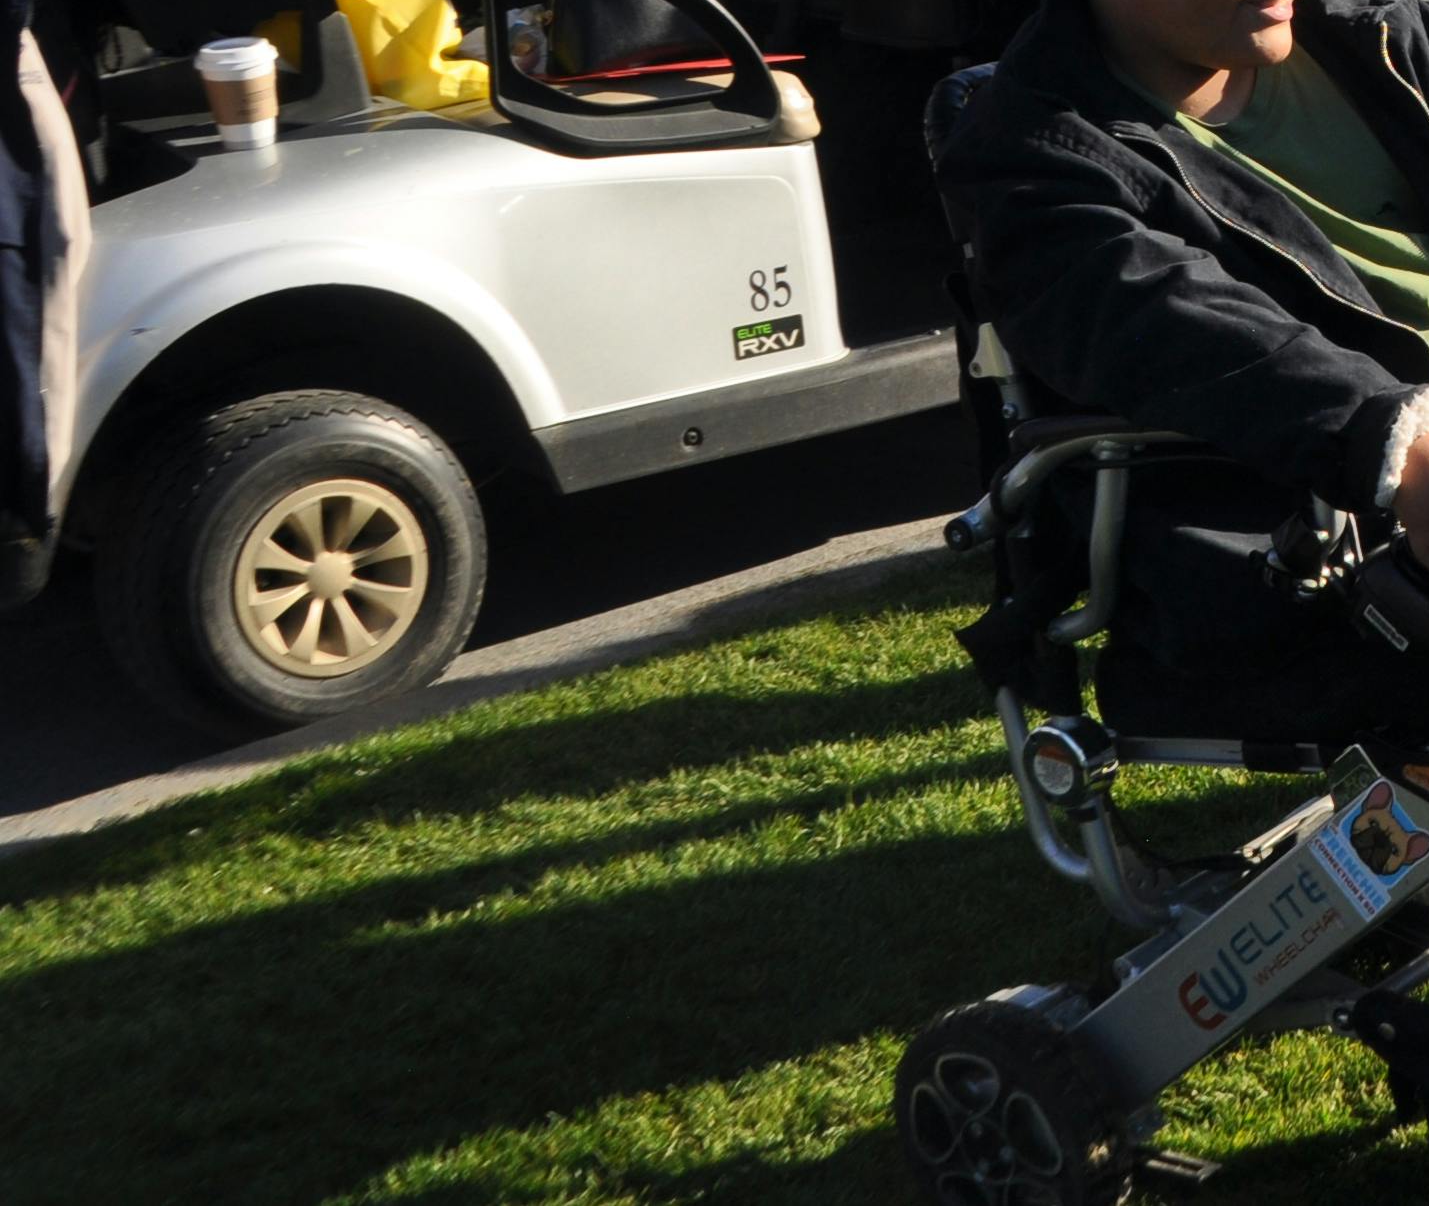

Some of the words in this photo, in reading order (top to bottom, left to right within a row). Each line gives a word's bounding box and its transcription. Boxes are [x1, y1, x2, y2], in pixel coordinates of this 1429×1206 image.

[749, 264, 792, 312] 85
[737, 323, 773, 340] ELITE
[738, 328, 800, 358] RXV
